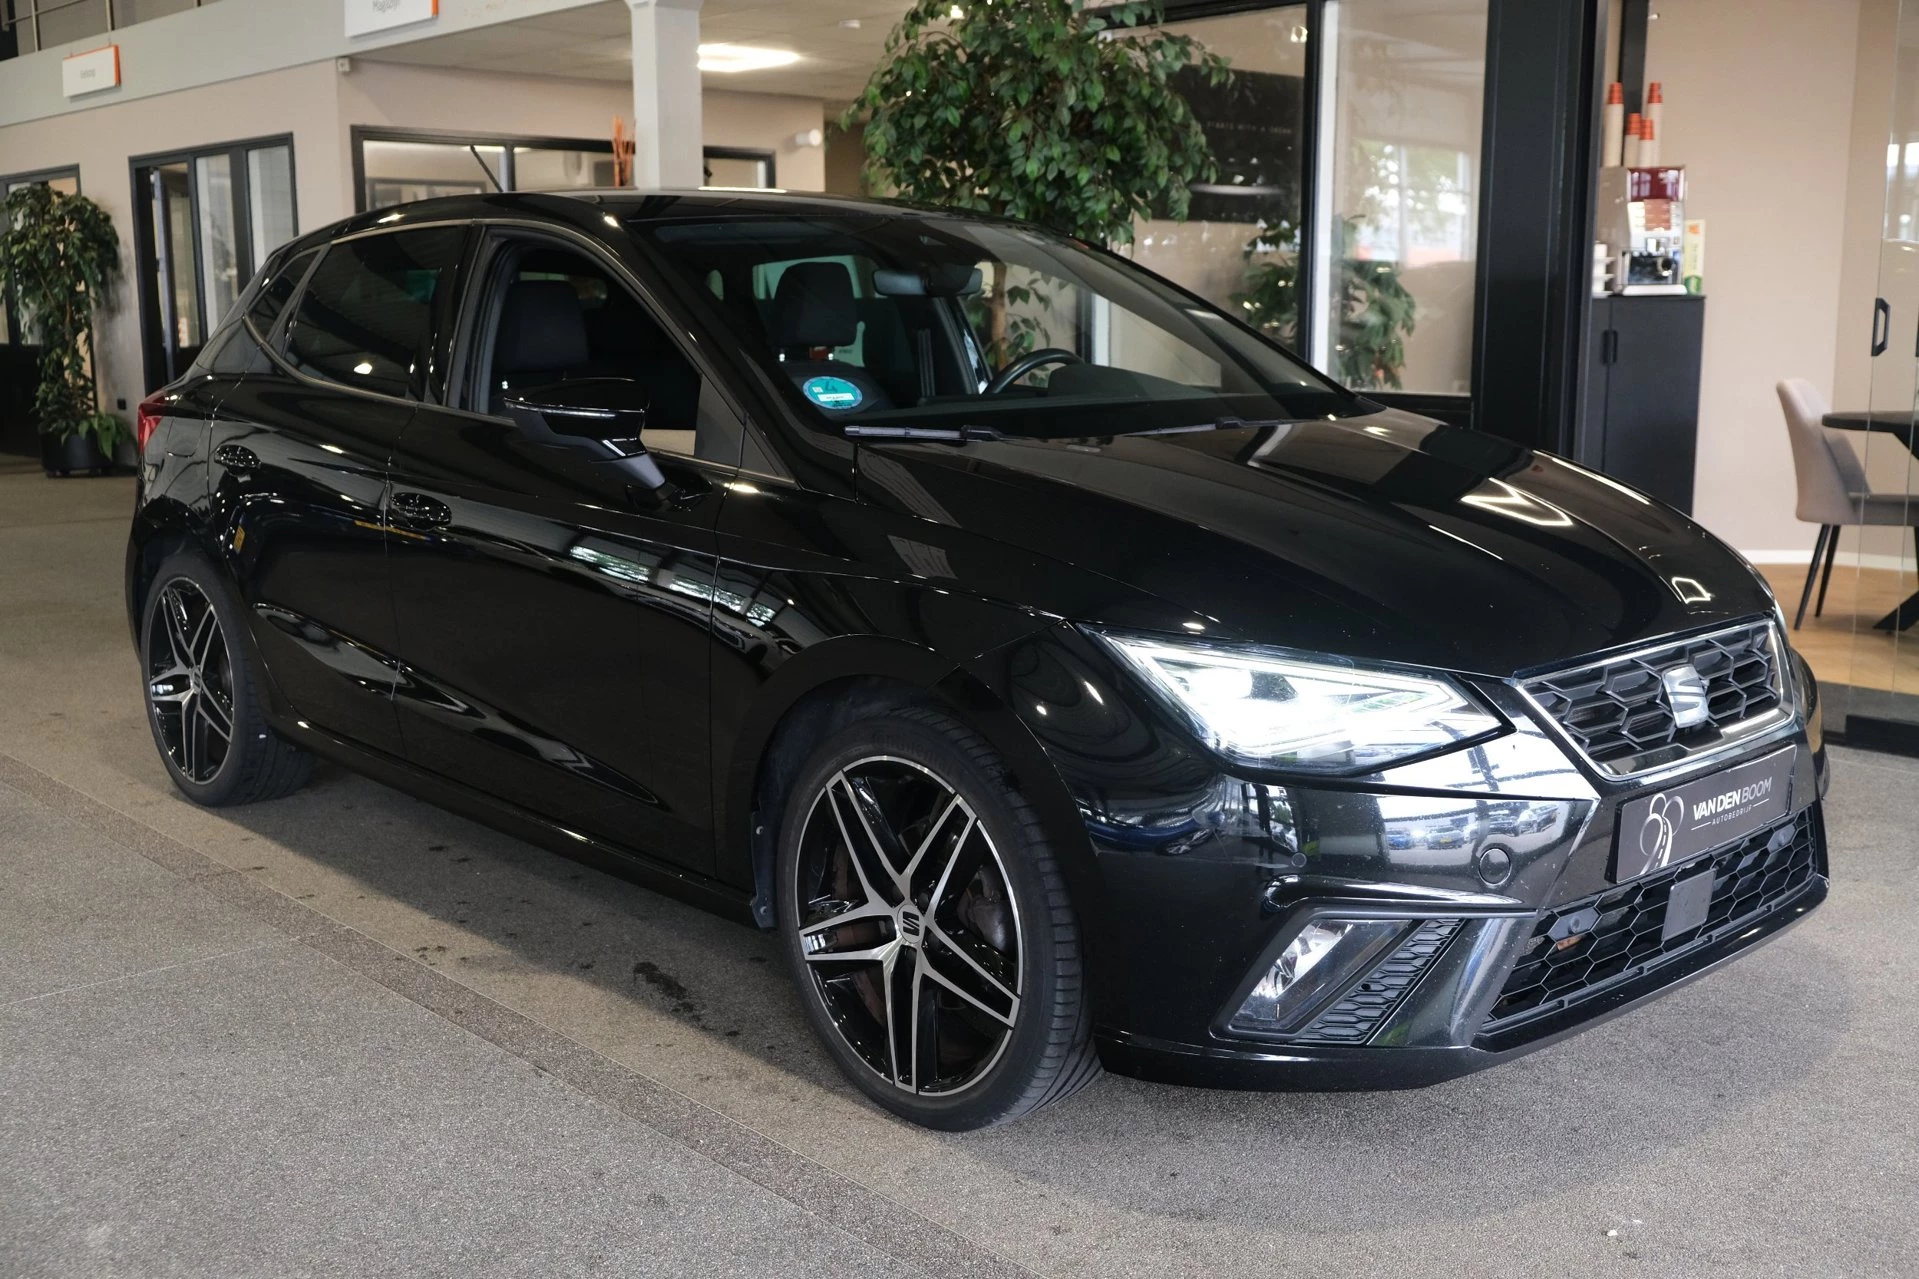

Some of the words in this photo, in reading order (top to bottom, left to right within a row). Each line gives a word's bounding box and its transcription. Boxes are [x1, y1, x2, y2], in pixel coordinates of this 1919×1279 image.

[1692, 797, 1717, 821] VAN
[1717, 788, 1742, 812] DEN
[1741, 776, 1773, 803] BOOM
[1711, 804, 1753, 826] AUTOBEDRIJF
